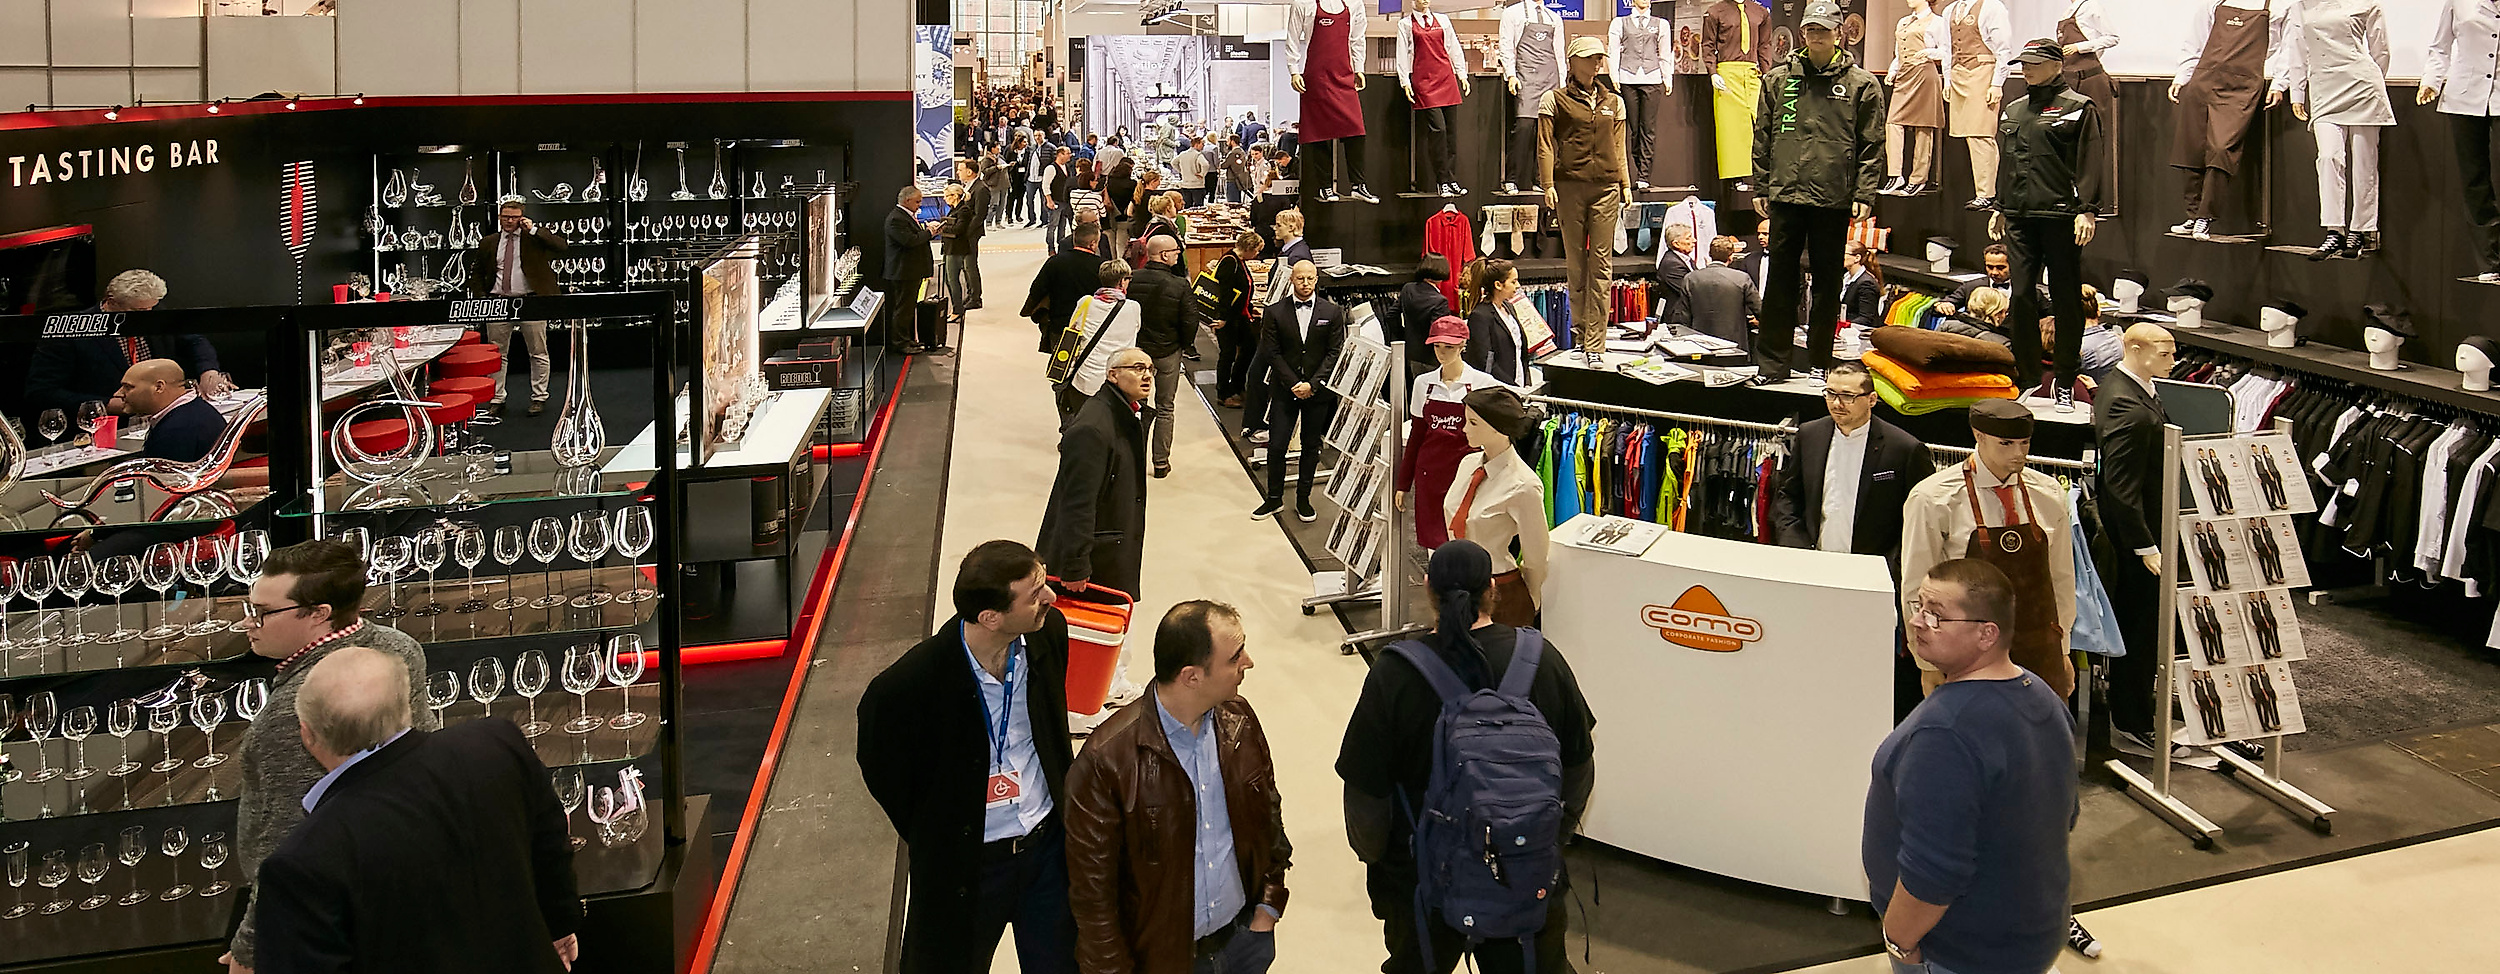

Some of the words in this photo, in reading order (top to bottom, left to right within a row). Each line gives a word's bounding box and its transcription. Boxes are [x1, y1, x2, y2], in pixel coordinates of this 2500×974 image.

[1133, 61, 1165, 69] willow
[1780, 78, 1801, 133] TRAIN
[8, 144, 155, 187] TASTING
[170, 139, 219, 168] BAR
[449, 299, 508, 318] RIEDEL
[43, 314, 109, 334] RIEDEL
[780, 372, 812, 384] RIEDEL
[1648, 610, 1755, 635] como
[1665, 631, 1704, 642] CORPORATE
[1706, 636, 1737, 646] FASHION
